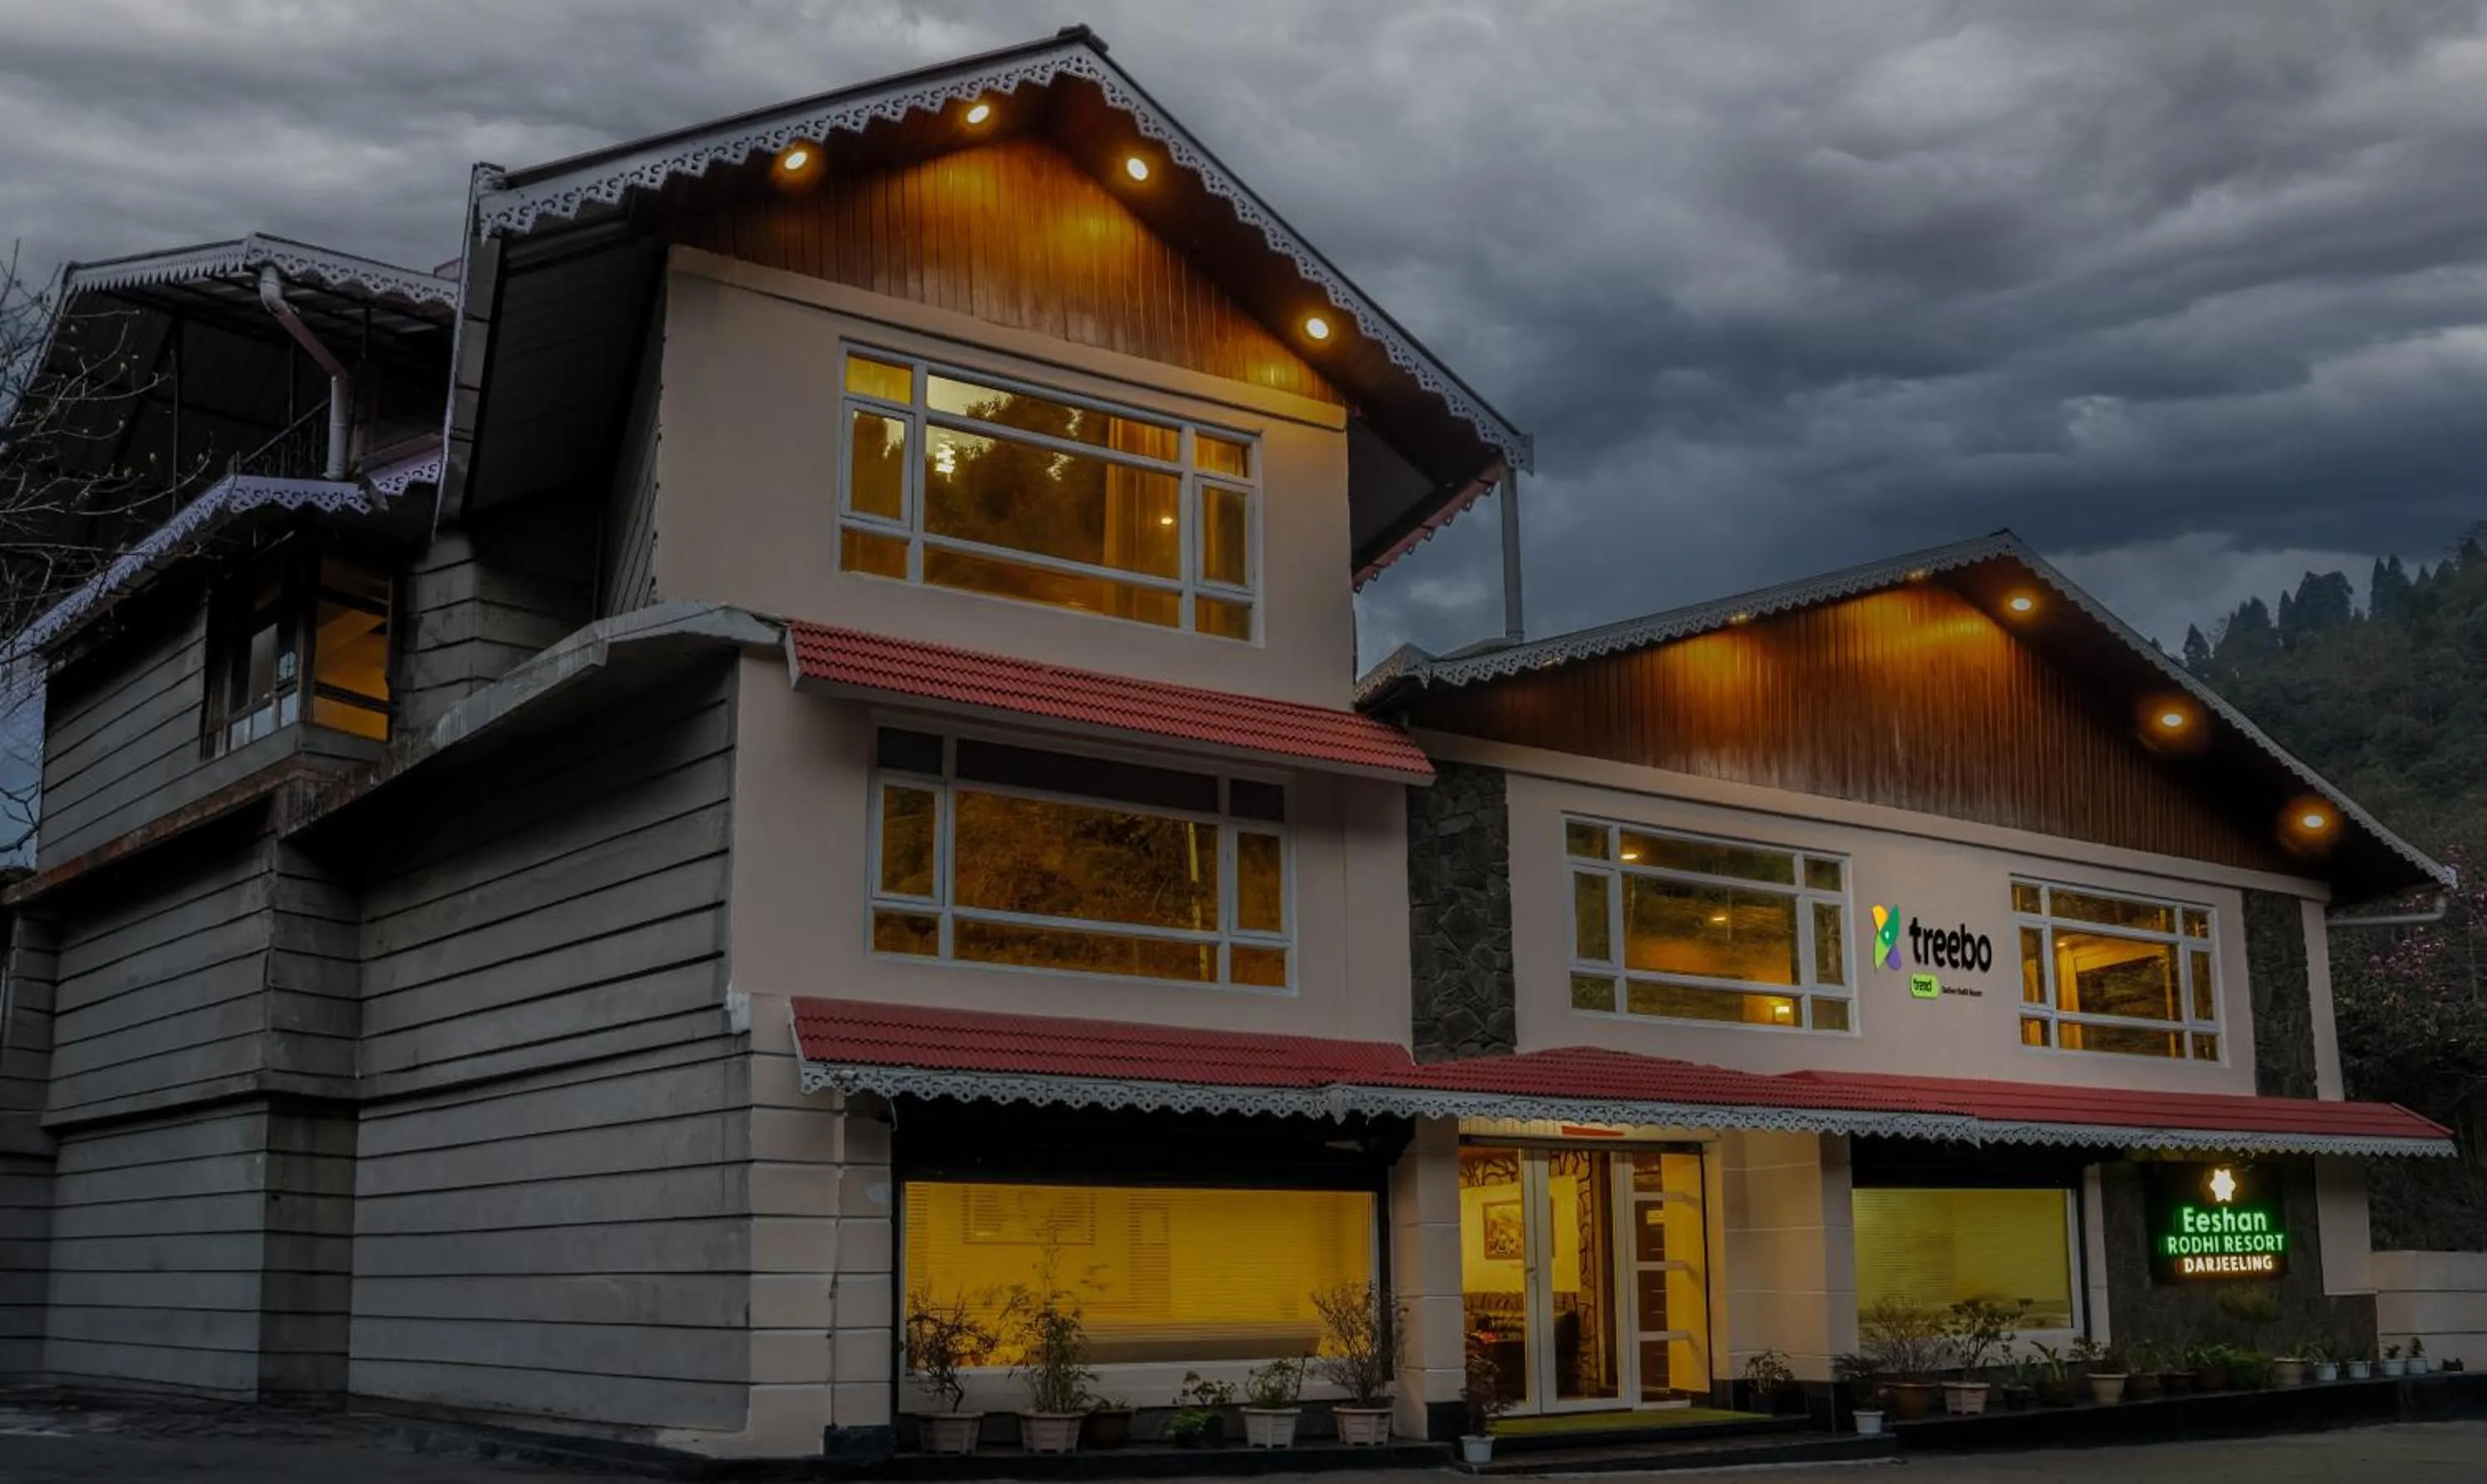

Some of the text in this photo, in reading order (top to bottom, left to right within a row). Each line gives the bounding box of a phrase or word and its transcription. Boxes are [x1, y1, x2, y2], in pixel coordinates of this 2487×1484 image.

[1909, 917, 1992, 972] treebo
[1913, 978, 1932, 992] trend
[2183, 1206, 2267, 1233] Eeshan
[2168, 1234, 2285, 1254] RODHI RESORT
[2184, 1254, 2273, 1273] DARJEELING
